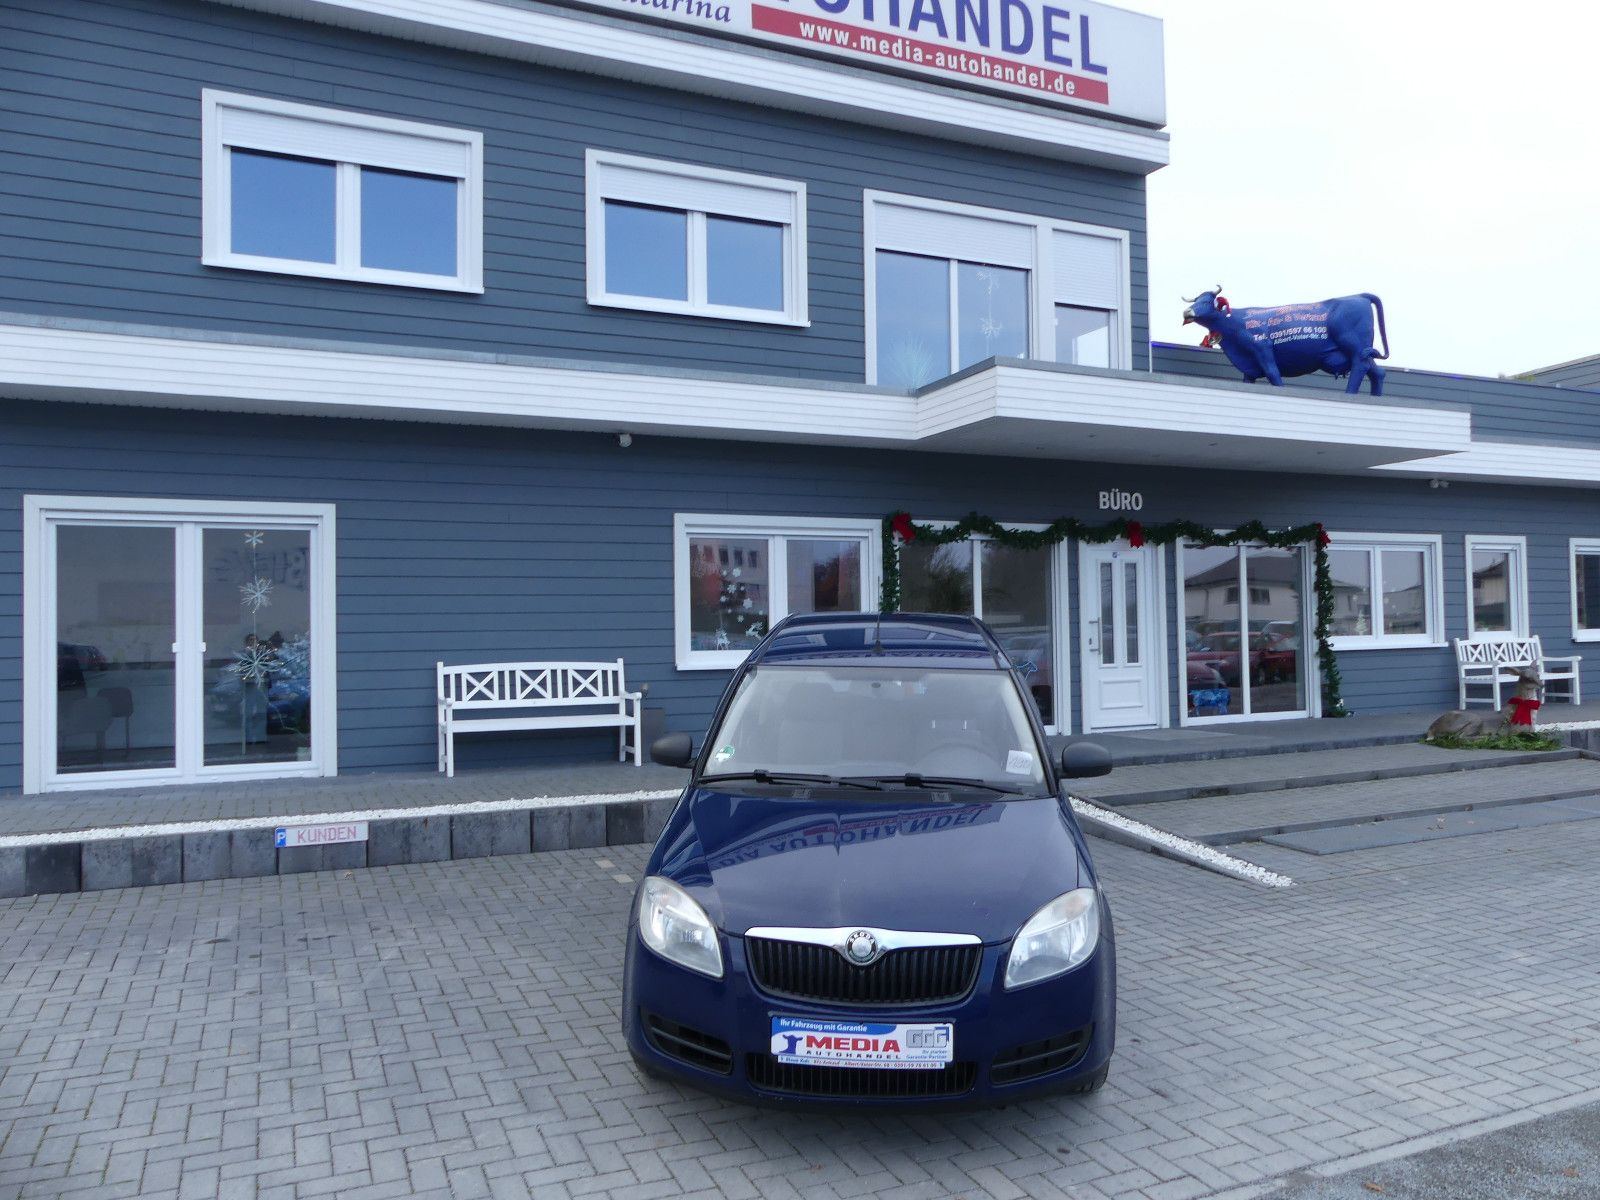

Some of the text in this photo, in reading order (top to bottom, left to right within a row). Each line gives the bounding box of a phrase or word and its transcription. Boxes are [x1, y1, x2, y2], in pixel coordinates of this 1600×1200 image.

[799, 20, 1076, 96] www.media-autohandel.de
[1098, 488, 1143, 511] BÜRO
[297, 825, 357, 844] KUNDEN
[780, 1018, 868, 1032] Ihr Fahrzeug mit Garantie
[806, 1035, 901, 1052] MEDIA
[806, 1050, 901, 1059] AUTOHANDEL
